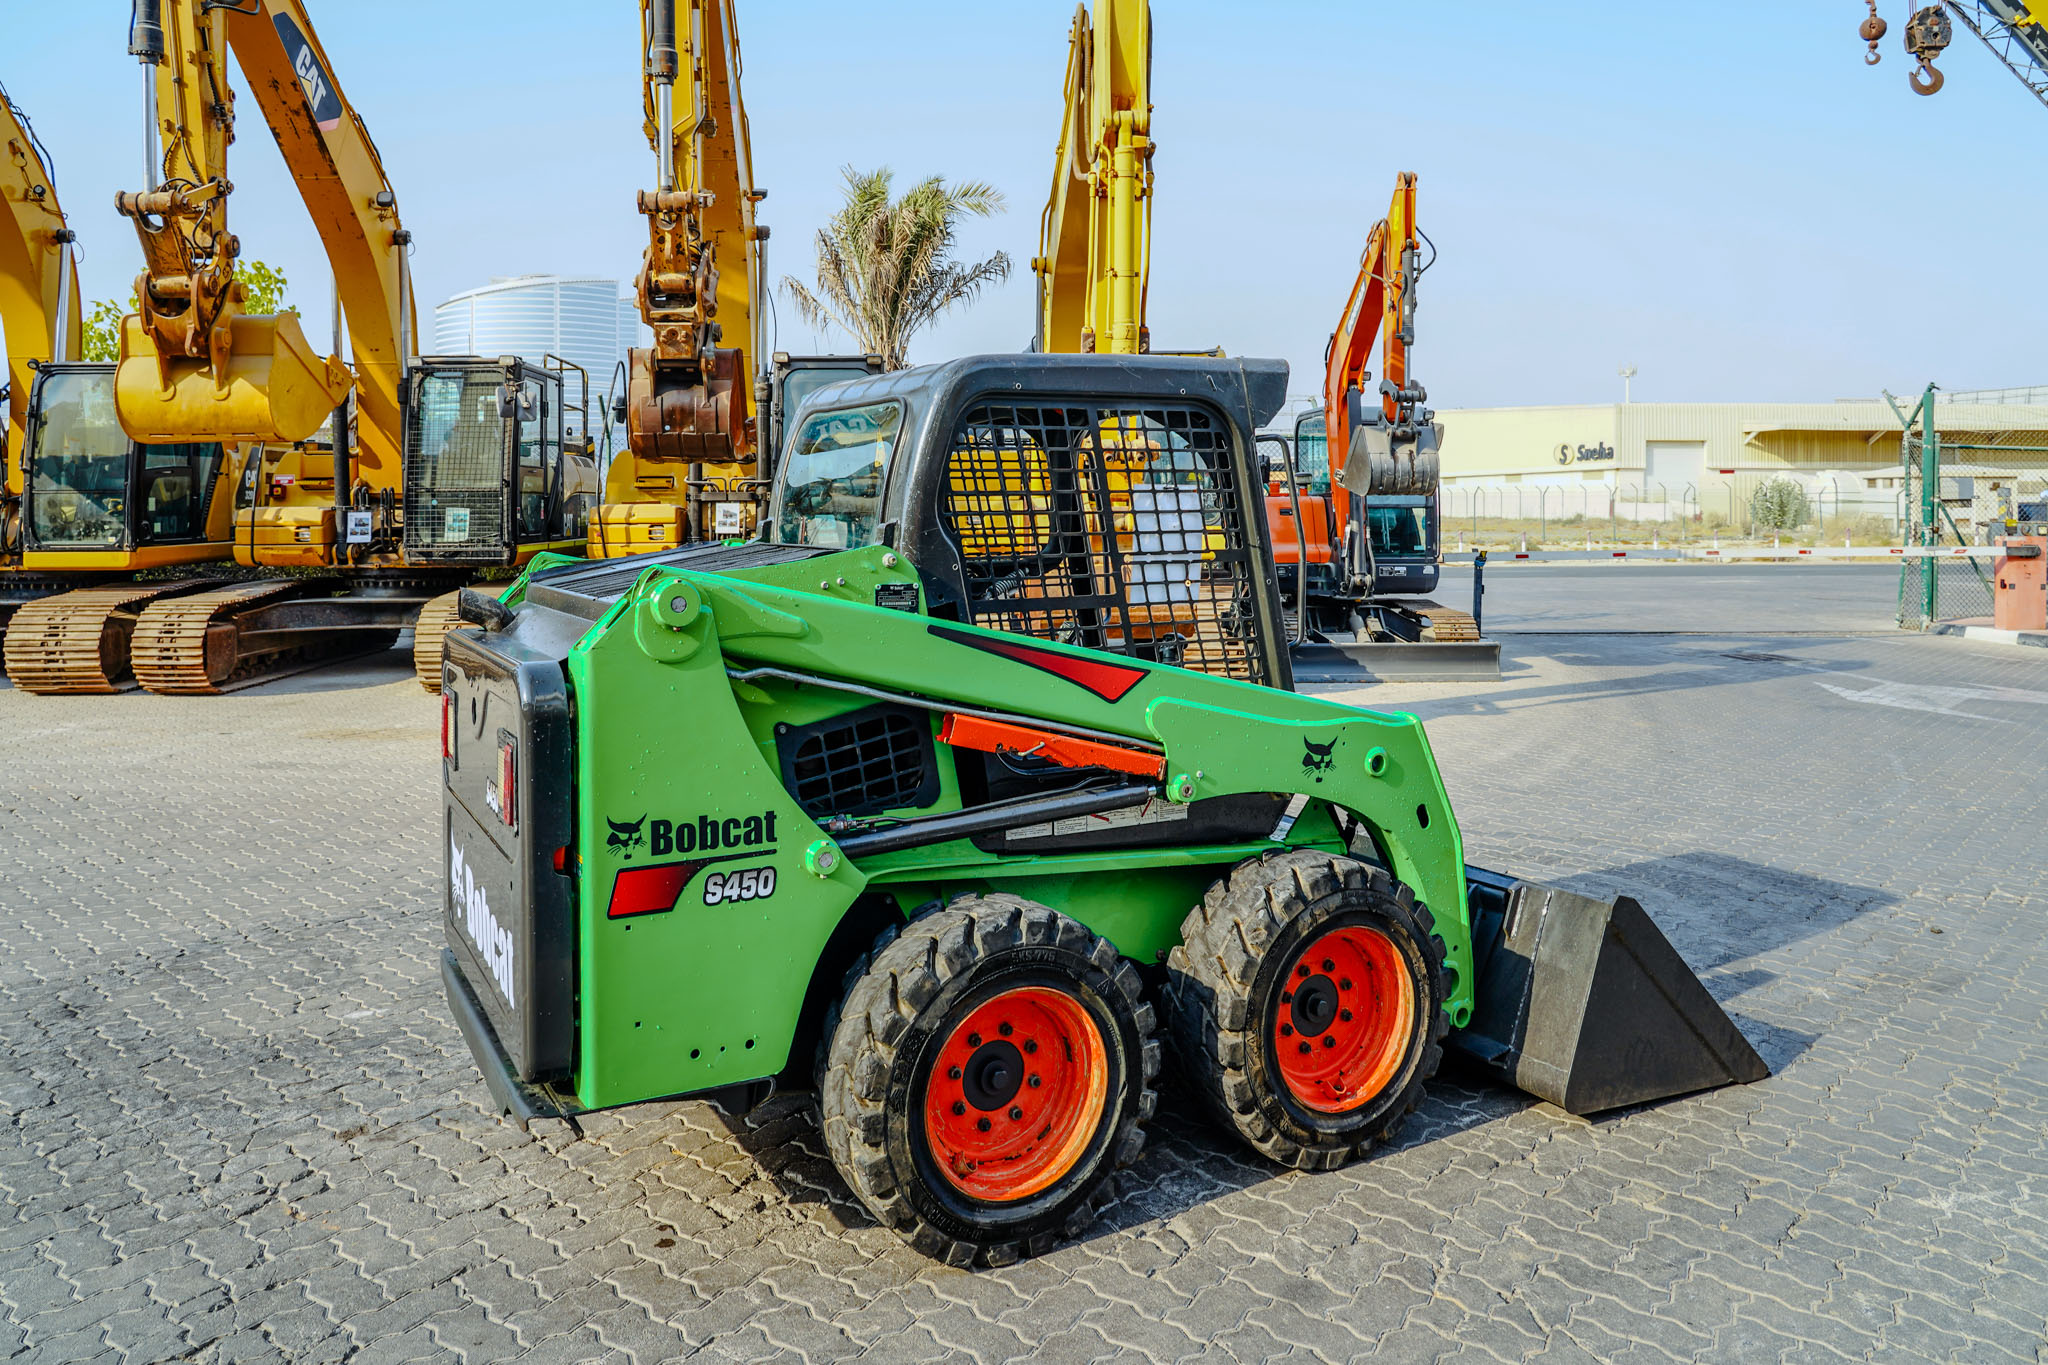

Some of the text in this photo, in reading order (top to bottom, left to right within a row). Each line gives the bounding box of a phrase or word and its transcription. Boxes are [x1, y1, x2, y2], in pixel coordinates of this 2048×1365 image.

[296, 44, 327, 112] CAT
[1577, 441, 1614, 461] Sneha
[245, 469, 257, 487] CA
[651, 811, 777, 856] Bobcat
[703, 866, 777, 906] S450
[465, 863, 515, 1010] Bobcat
